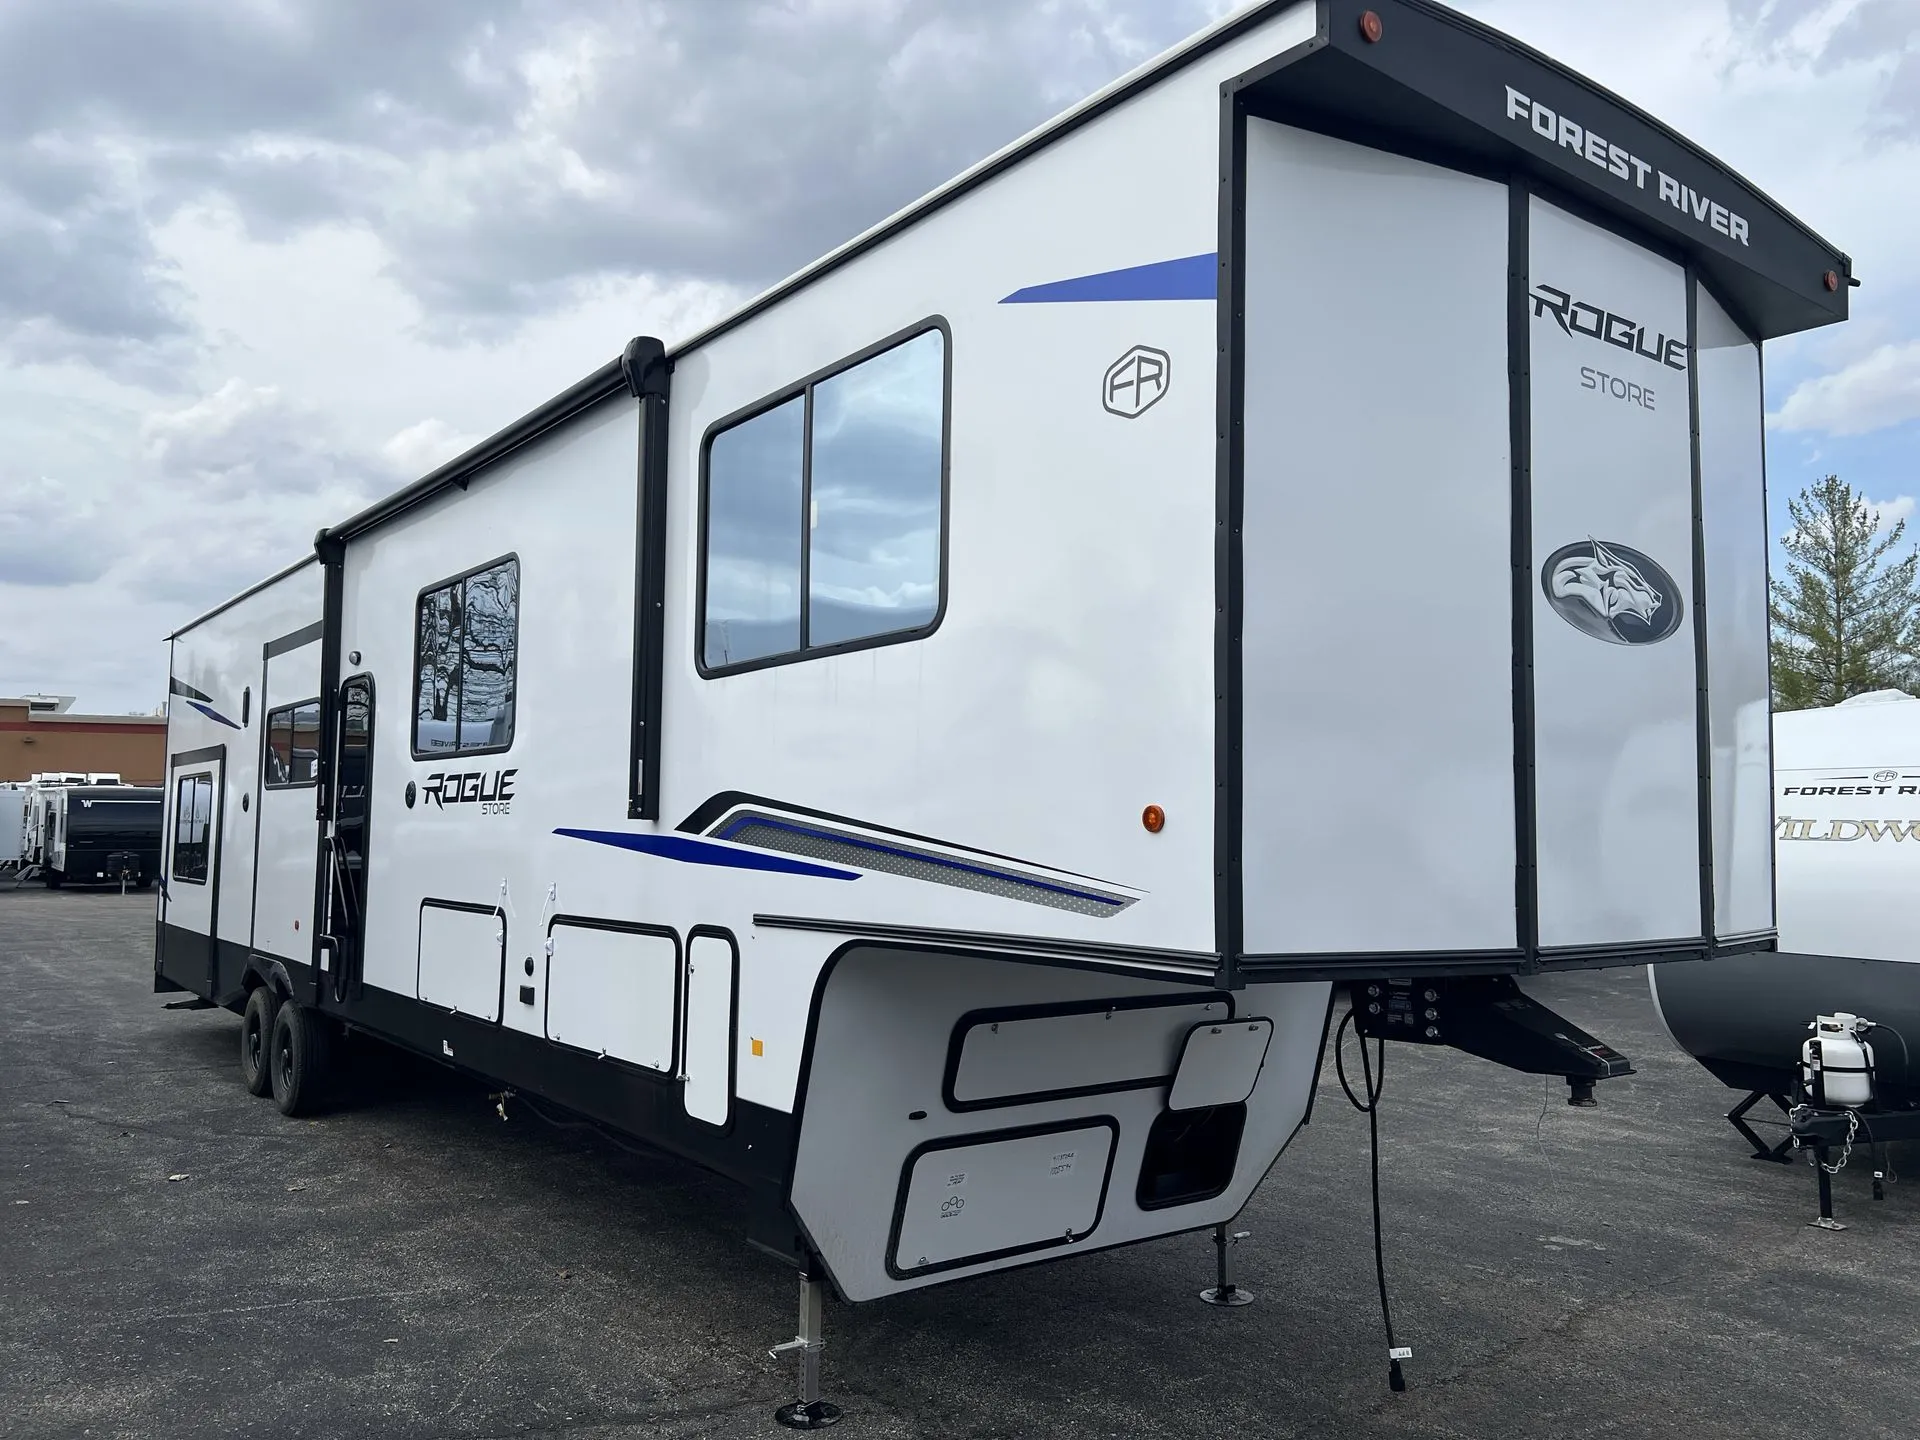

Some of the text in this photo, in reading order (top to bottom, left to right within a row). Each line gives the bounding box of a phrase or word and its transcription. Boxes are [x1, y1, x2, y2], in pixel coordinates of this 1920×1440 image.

[1504, 84, 1750, 247] FOREST RIVER
[1529, 284, 1688, 371] ROGUE
[1580, 366, 1656, 411] STORE
[422, 769, 519, 811] ROGUE
[482, 802, 511, 815] STORE
[1783, 786, 1920, 796] FOREST R
